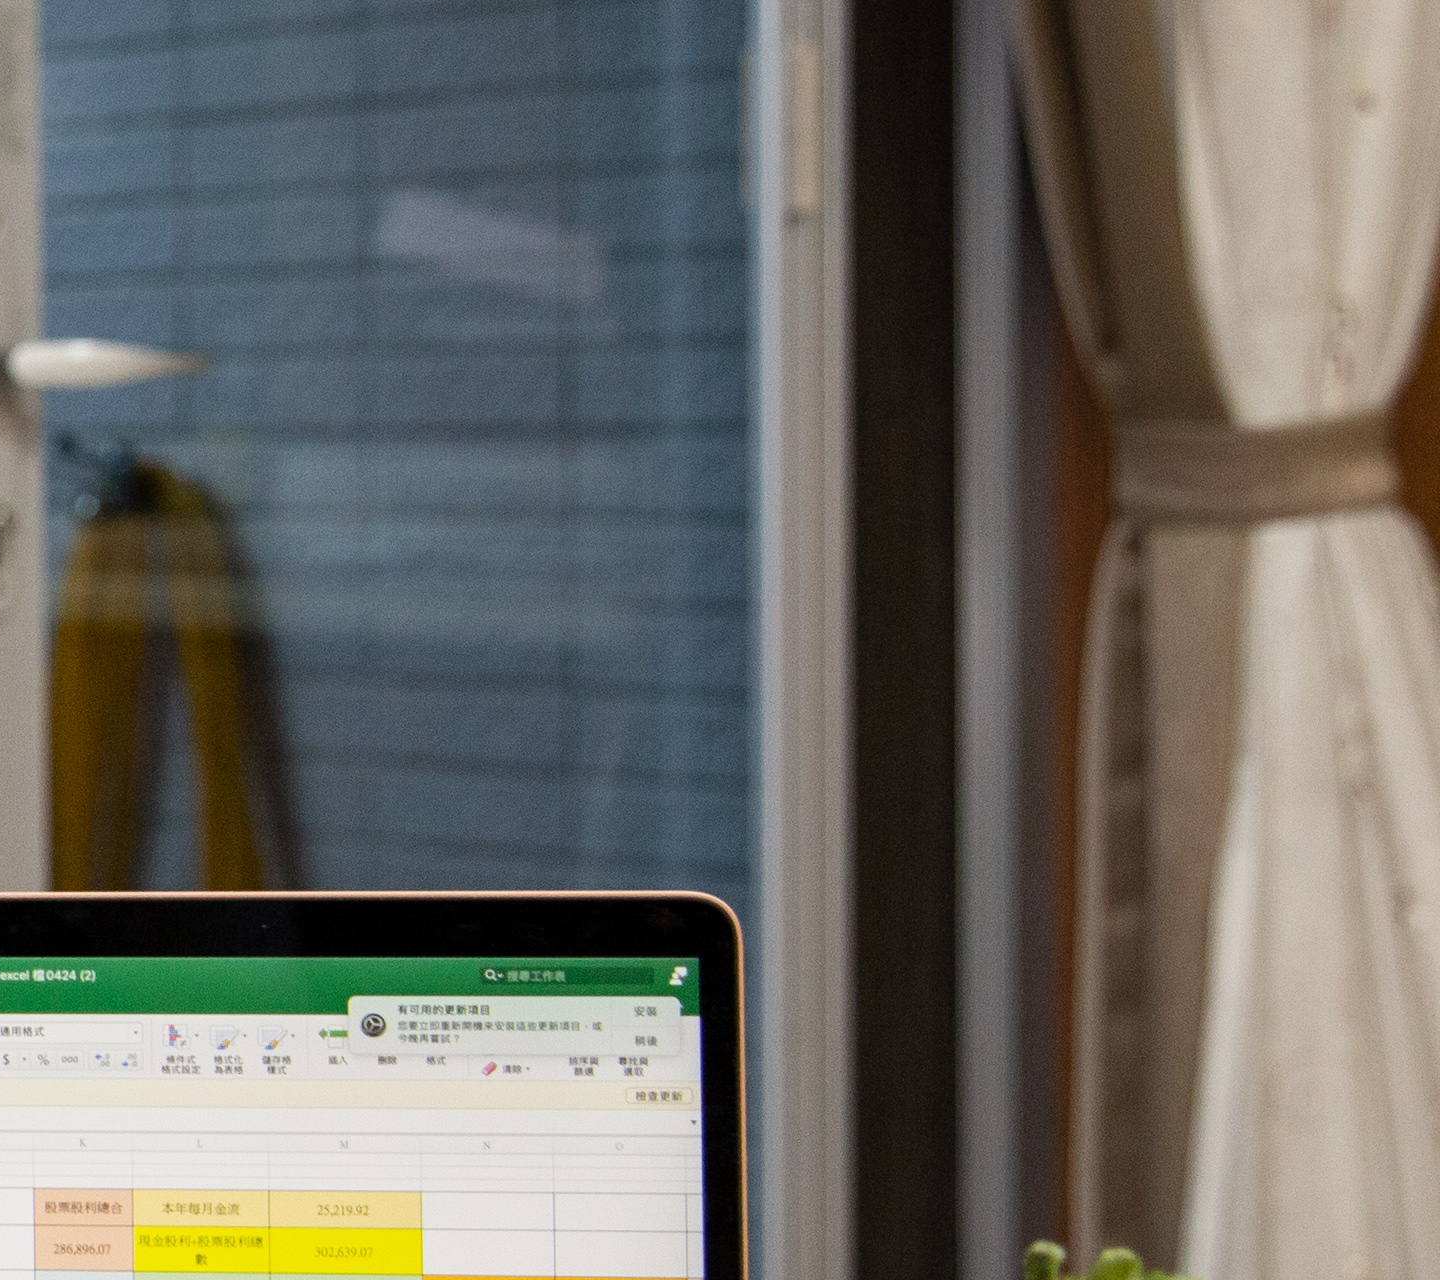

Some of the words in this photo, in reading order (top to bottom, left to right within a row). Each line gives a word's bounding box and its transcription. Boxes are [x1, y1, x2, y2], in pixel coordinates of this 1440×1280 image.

[80, 970, 96, 983] (2)
[317, 1205, 369, 1217] 25,219.92
[53, 1243, 111, 1256] 286,896.07
[315, 1247, 373, 1258] 302,639.07
